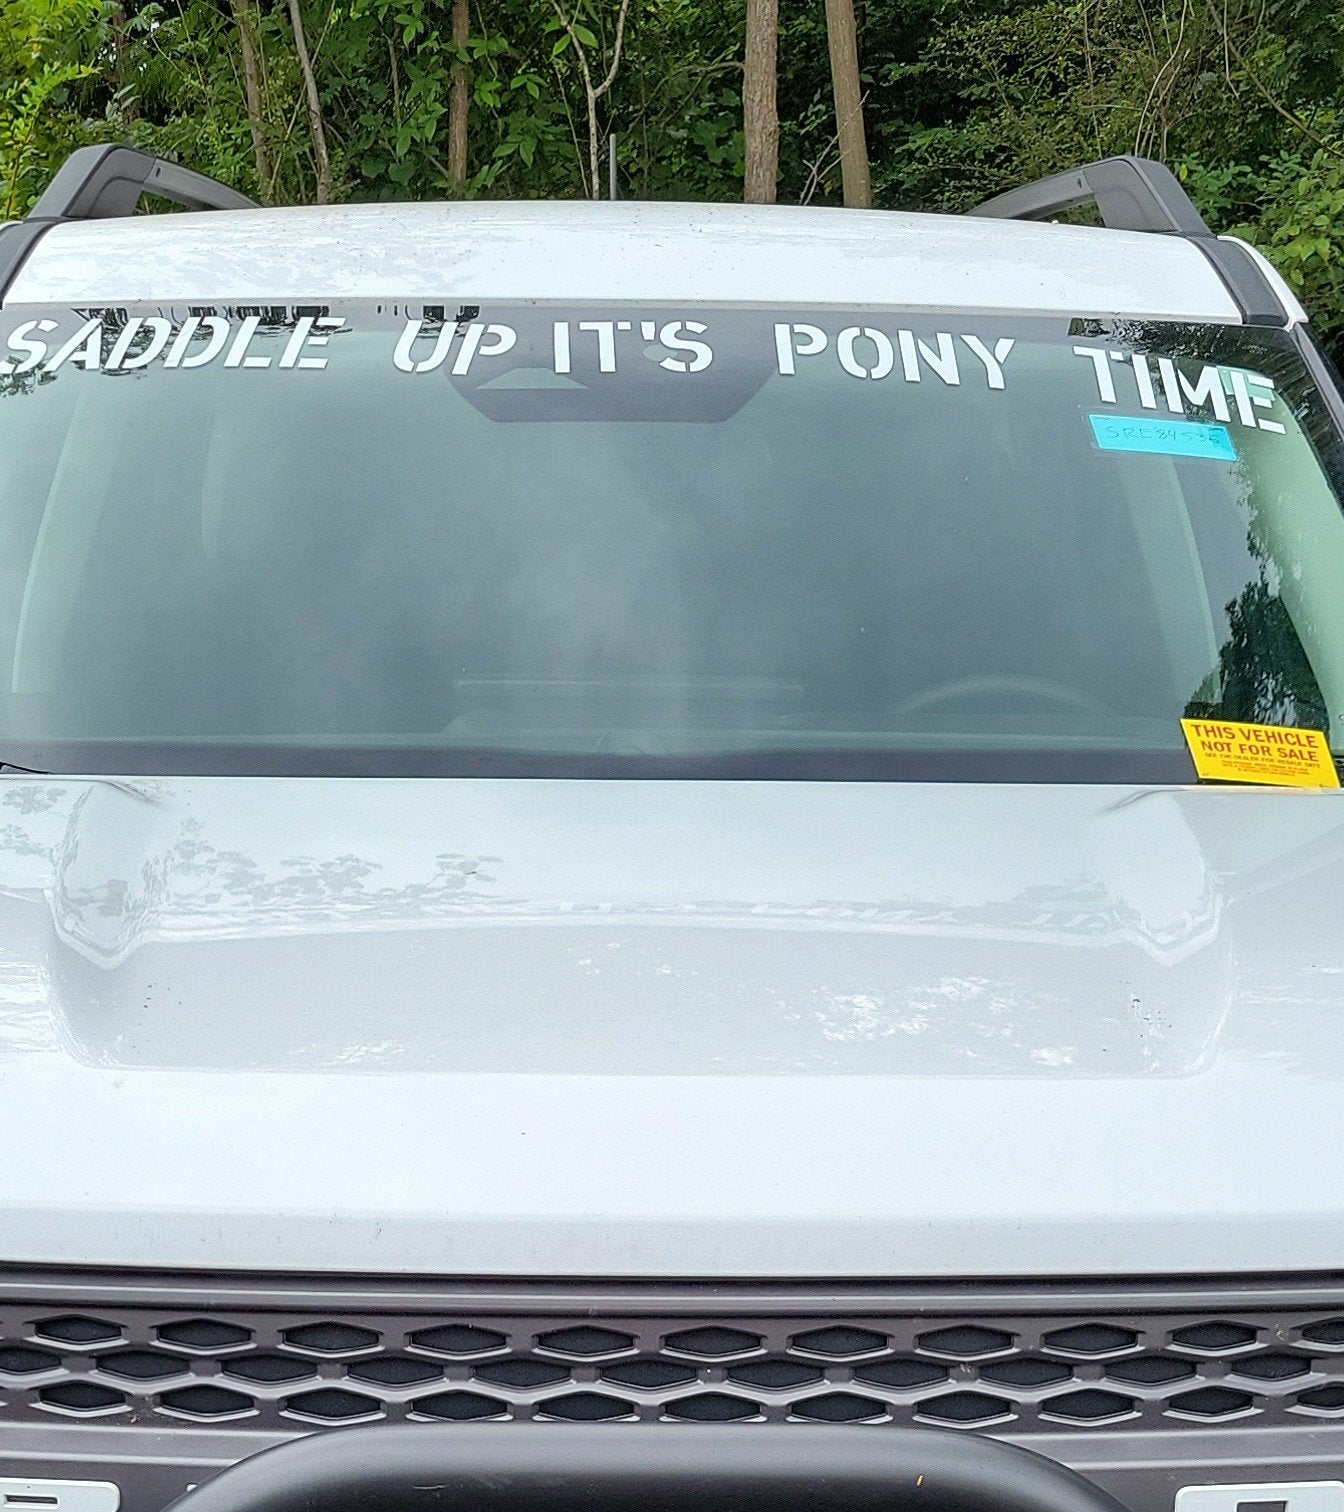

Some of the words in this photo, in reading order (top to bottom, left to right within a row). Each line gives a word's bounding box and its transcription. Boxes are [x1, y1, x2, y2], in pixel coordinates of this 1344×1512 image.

[392, 319, 516, 376] UP
[553, 320, 714, 374] IT'S
[773, 321, 1016, 390] PONY
[1072, 344, 1287, 434] TIME
[1191, 724, 1235, 740] THIS
[1239, 727, 1319, 749] VEHICLE
[1201, 740, 1232, 753] NOT
[1238, 743, 1272, 757] FOR
[1278, 747, 1320, 762] SALE
